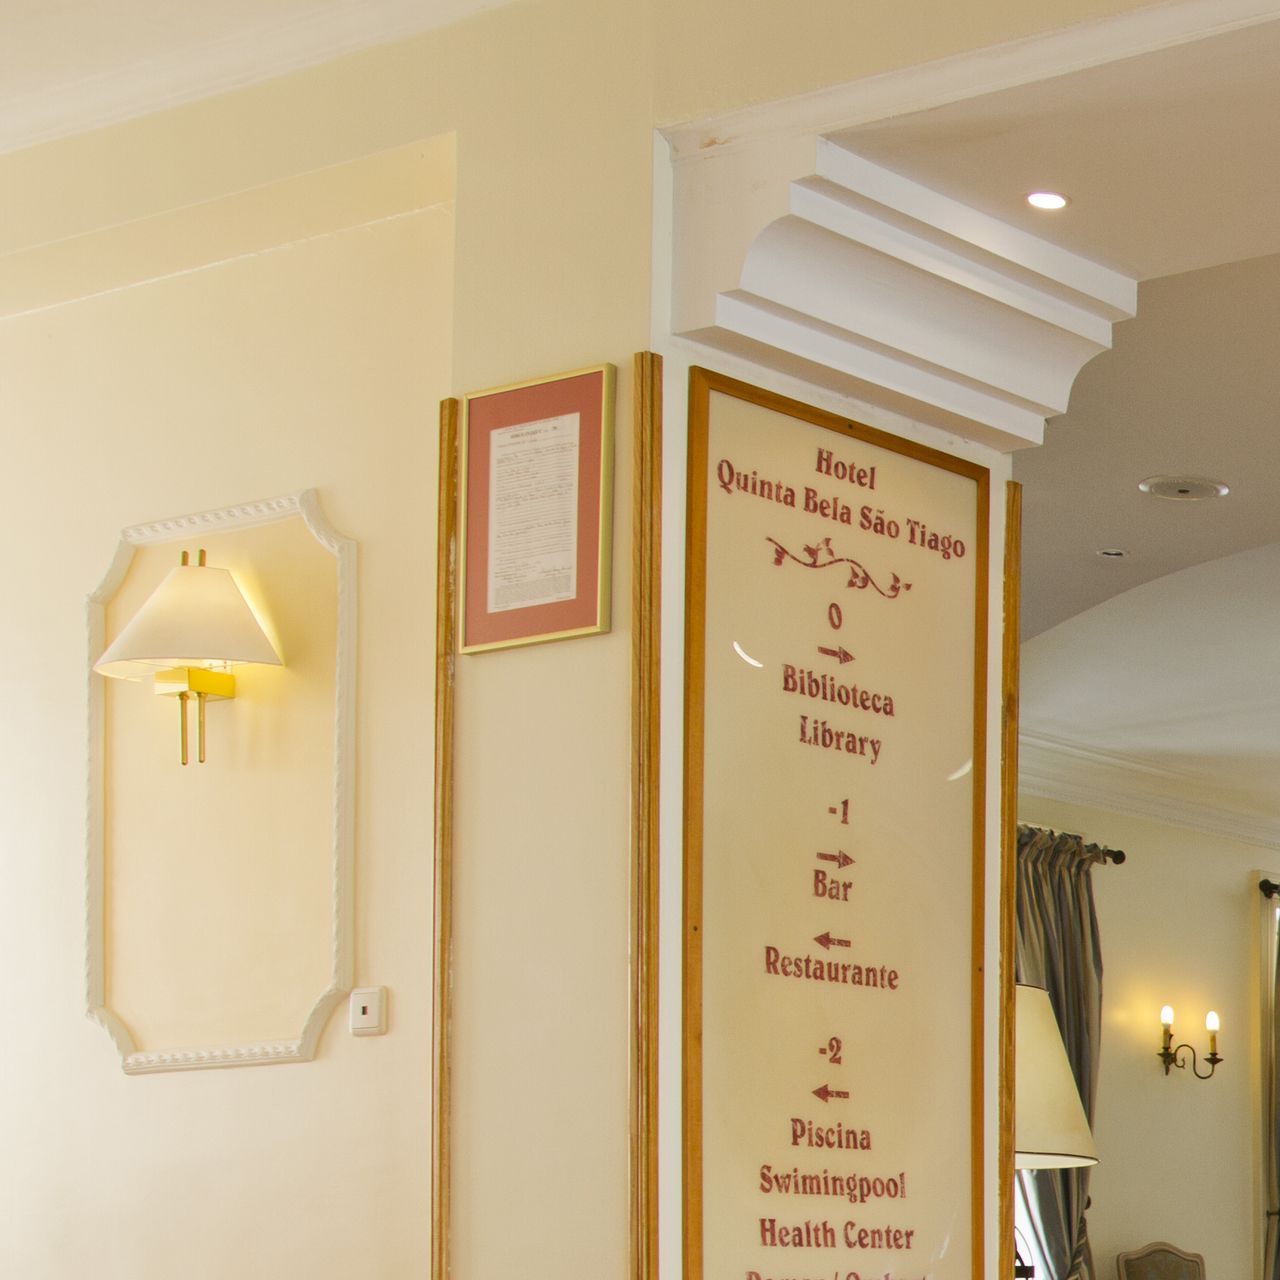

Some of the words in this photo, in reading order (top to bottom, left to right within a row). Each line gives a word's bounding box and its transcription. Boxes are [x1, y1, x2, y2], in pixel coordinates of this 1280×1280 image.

[815, 446, 877, 491] Hotel
[716, 458, 796, 509] Quinta
[803, 485, 852, 526] Bela
[858, 504, 901, 540] São
[905, 516, 967, 561] Tiago
[827, 601, 844, 631] 0
[782, 662, 896, 717] Biblioteca
[798, 714, 883, 766] Library
[828, 798, 850, 826] -1
[812, 868, 854, 903] Bar
[764, 944, 900, 991] Restaurante
[817, 1035, 843, 1066] -2
[790, 1116, 873, 1152] Piscina
[758, 1163, 907, 1204] Swimingpool
[758, 1216, 837, 1249] Health
[843, 1220, 916, 1250] Center
